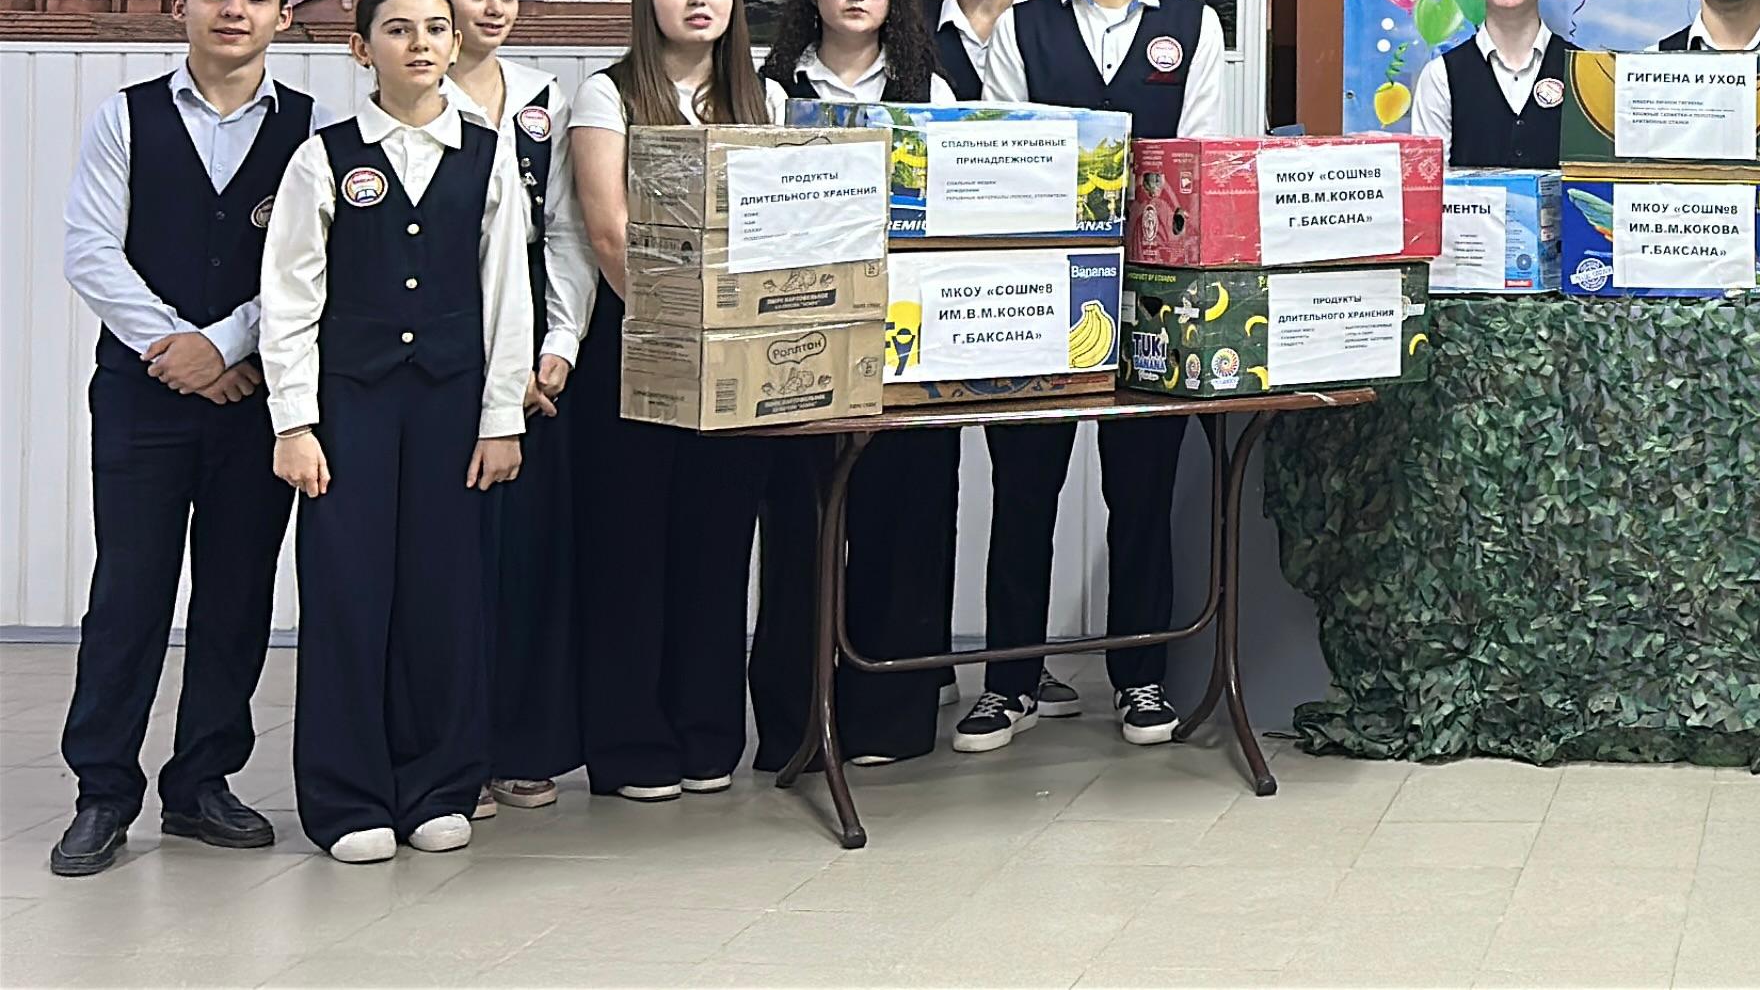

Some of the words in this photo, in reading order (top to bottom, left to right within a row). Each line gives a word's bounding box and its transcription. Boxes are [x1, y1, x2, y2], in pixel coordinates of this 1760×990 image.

[1627, 72, 1690, 84] ГИГИЕНА
[1695, 72, 1704, 84] И
[1709, 74, 1746, 86] УХОД
[941, 140, 998, 148] СПАЛЬНЫЕ
[1011, 139, 1067, 147] УКРЫВНЫЕ
[956, 156, 1053, 165] ПРИНАДЛЕЖНОСТИ
[781, 172, 839, 183] ПРОДУКТЫ
[1276, 172, 1315, 183] МКОУ
[740, 191, 820, 205] ДЛИТЕЛЬНОГО
[823, 186, 877, 198] ХРАНЕНИЯ
[1442, 204, 1491, 214] МЕНТЫ
[1631, 203, 1670, 213] МКОУ
[888, 220, 926, 231] REMI
[1075, 221, 1113, 231] ANAS
[1071, 264, 1117, 278] Bananas
[941, 286, 982, 298] МКОУ
[1312, 295, 1362, 305] ПРОДУКТЫ
[1278, 312, 1345, 324] ДЛИТЕЛЬНОГО
[1347, 309, 1394, 319] ХРАНЕНИЯ
[772, 339, 823, 360] Роллтон
